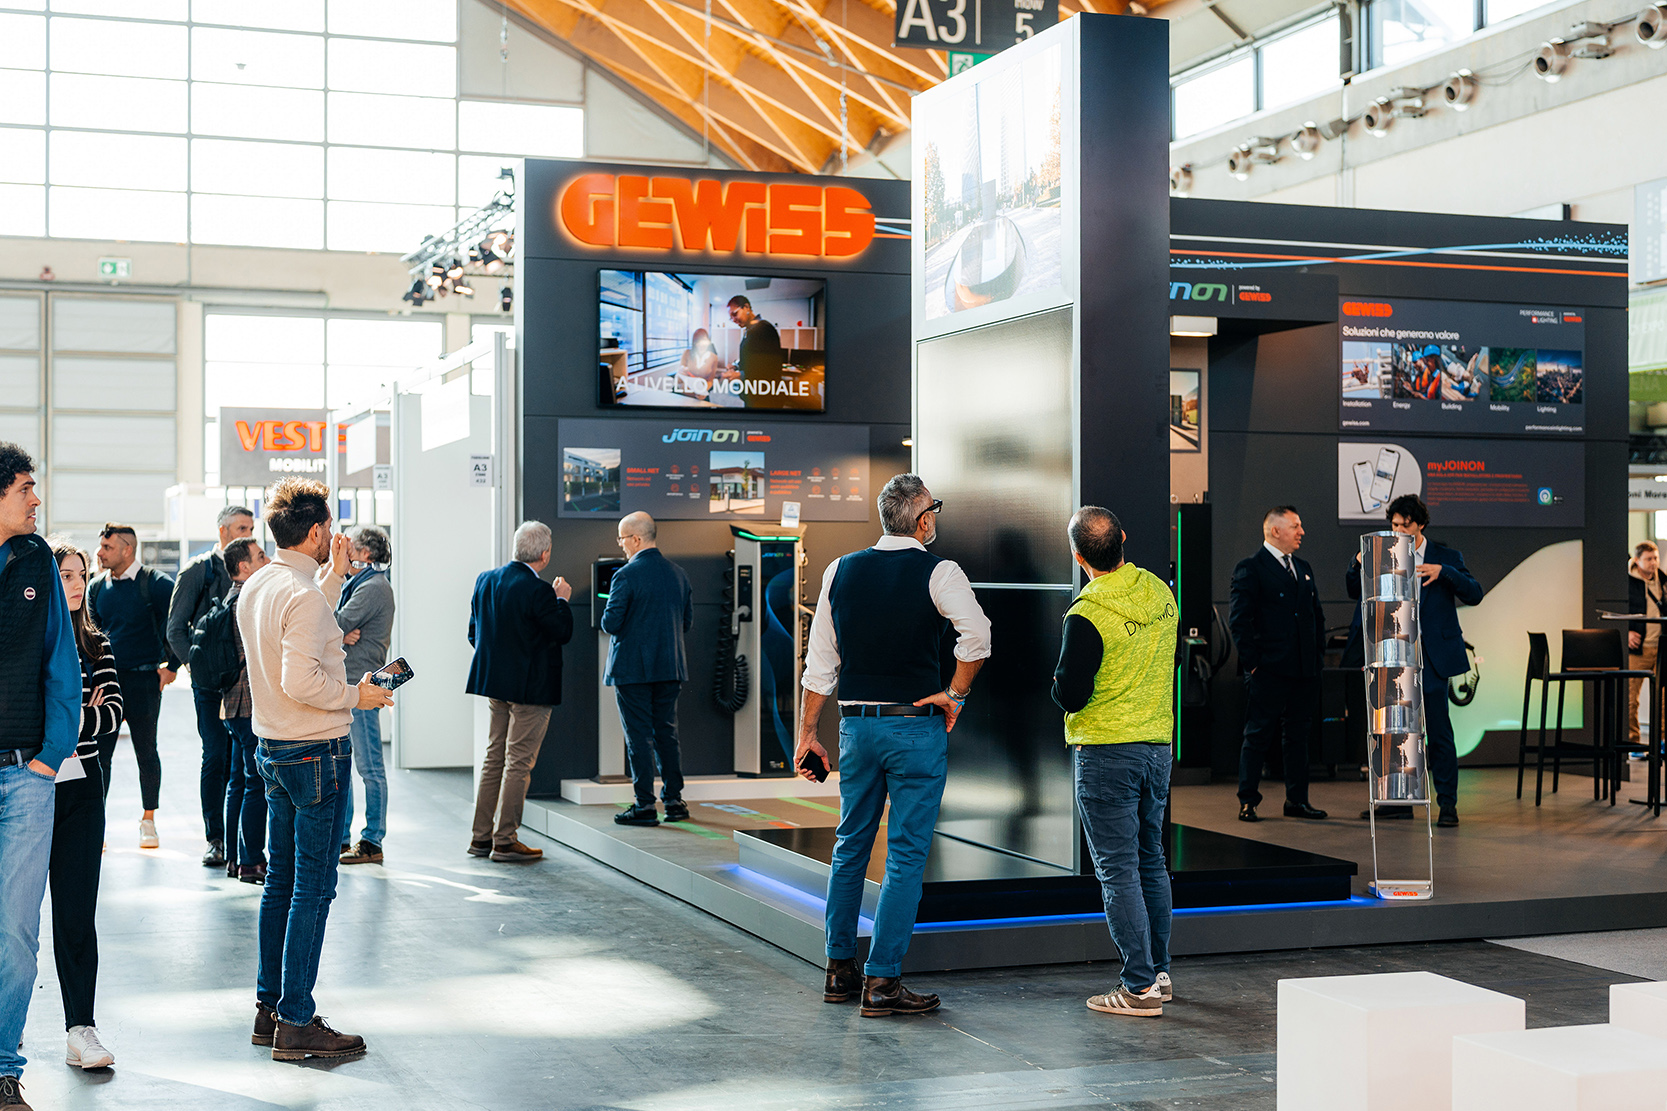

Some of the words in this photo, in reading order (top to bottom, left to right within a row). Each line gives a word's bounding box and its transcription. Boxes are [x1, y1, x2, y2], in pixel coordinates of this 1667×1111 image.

[897, 0, 967, 44] A3
[1015, 12, 1035, 44] 5
[1169, 282, 1228, 301] non
[1342, 325, 1379, 337] Soluzioni
[1380, 327, 1396, 338] che
[1396, 329, 1434, 340] generano
[1435, 330, 1460, 340] valore
[616, 375, 630, 391] A
[634, 376, 708, 394] LIVELLO
[713, 378, 810, 396] MONDIALE
[1392, 400, 1411, 410] Energy
[1441, 402, 1462, 412] Building
[1489, 403, 1510, 412] Mobility
[1536, 405, 1557, 414] Lighting
[269, 458, 328, 473] MOBILIT
[473, 463, 488, 472] A3
[1427, 460, 1485, 472] myJOINON
